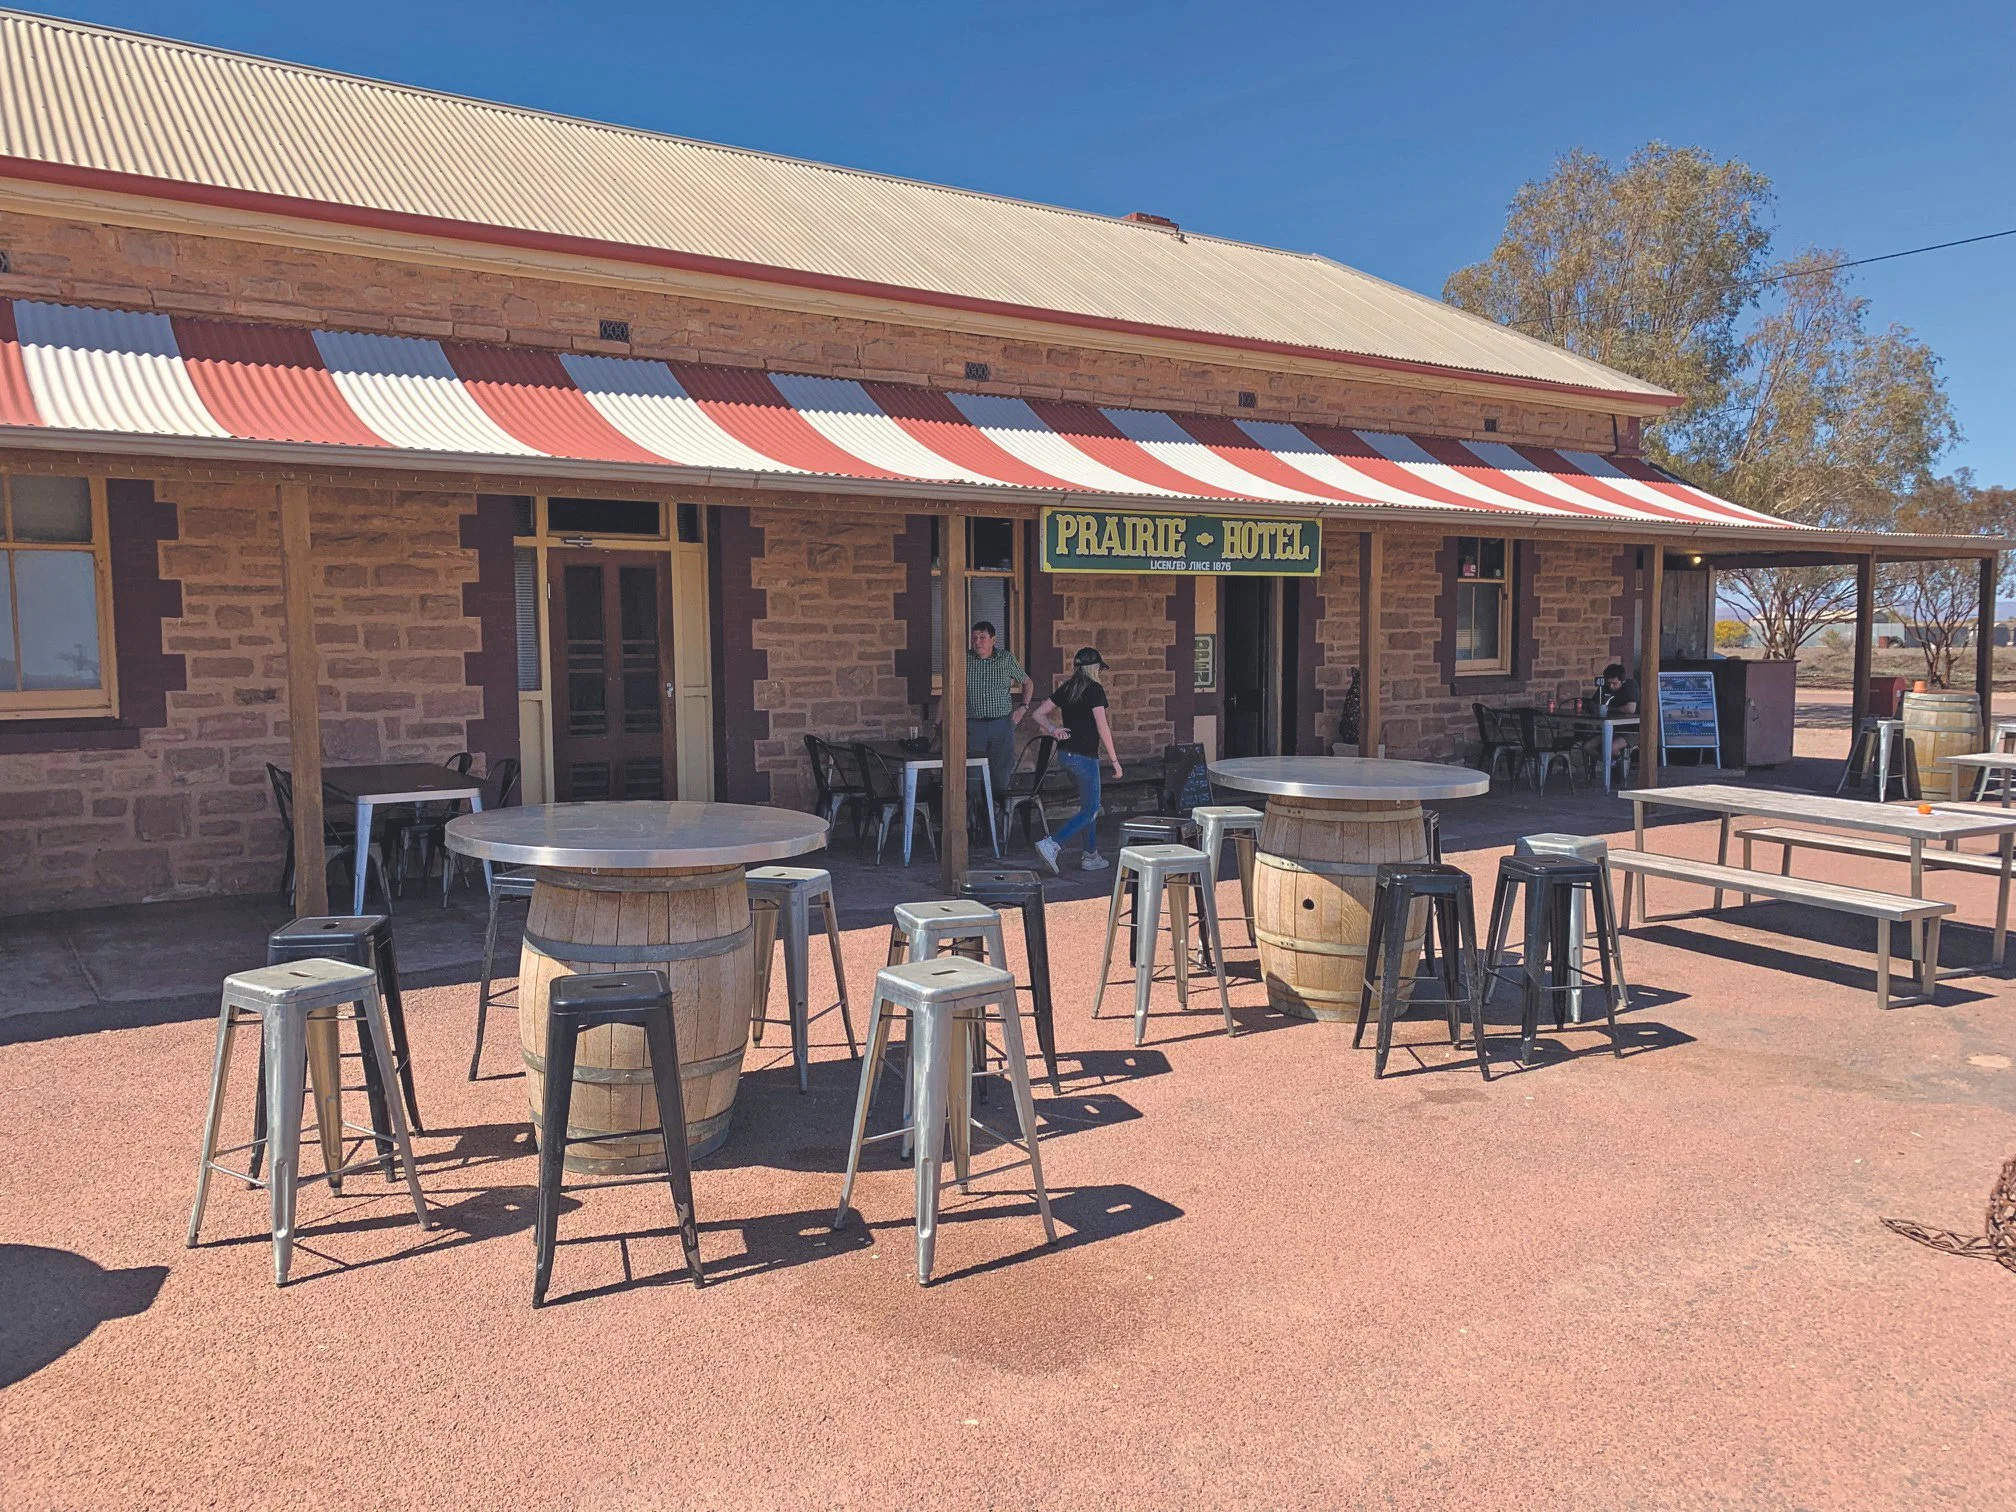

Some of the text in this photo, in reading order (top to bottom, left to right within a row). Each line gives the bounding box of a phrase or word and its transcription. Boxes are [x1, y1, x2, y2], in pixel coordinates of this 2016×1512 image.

[1055, 514, 1310, 561] PRAIRIE HOTEL
[1150, 559, 1232, 571] LICENSED SINCE 1876
[1596, 677, 1605, 686] 40
